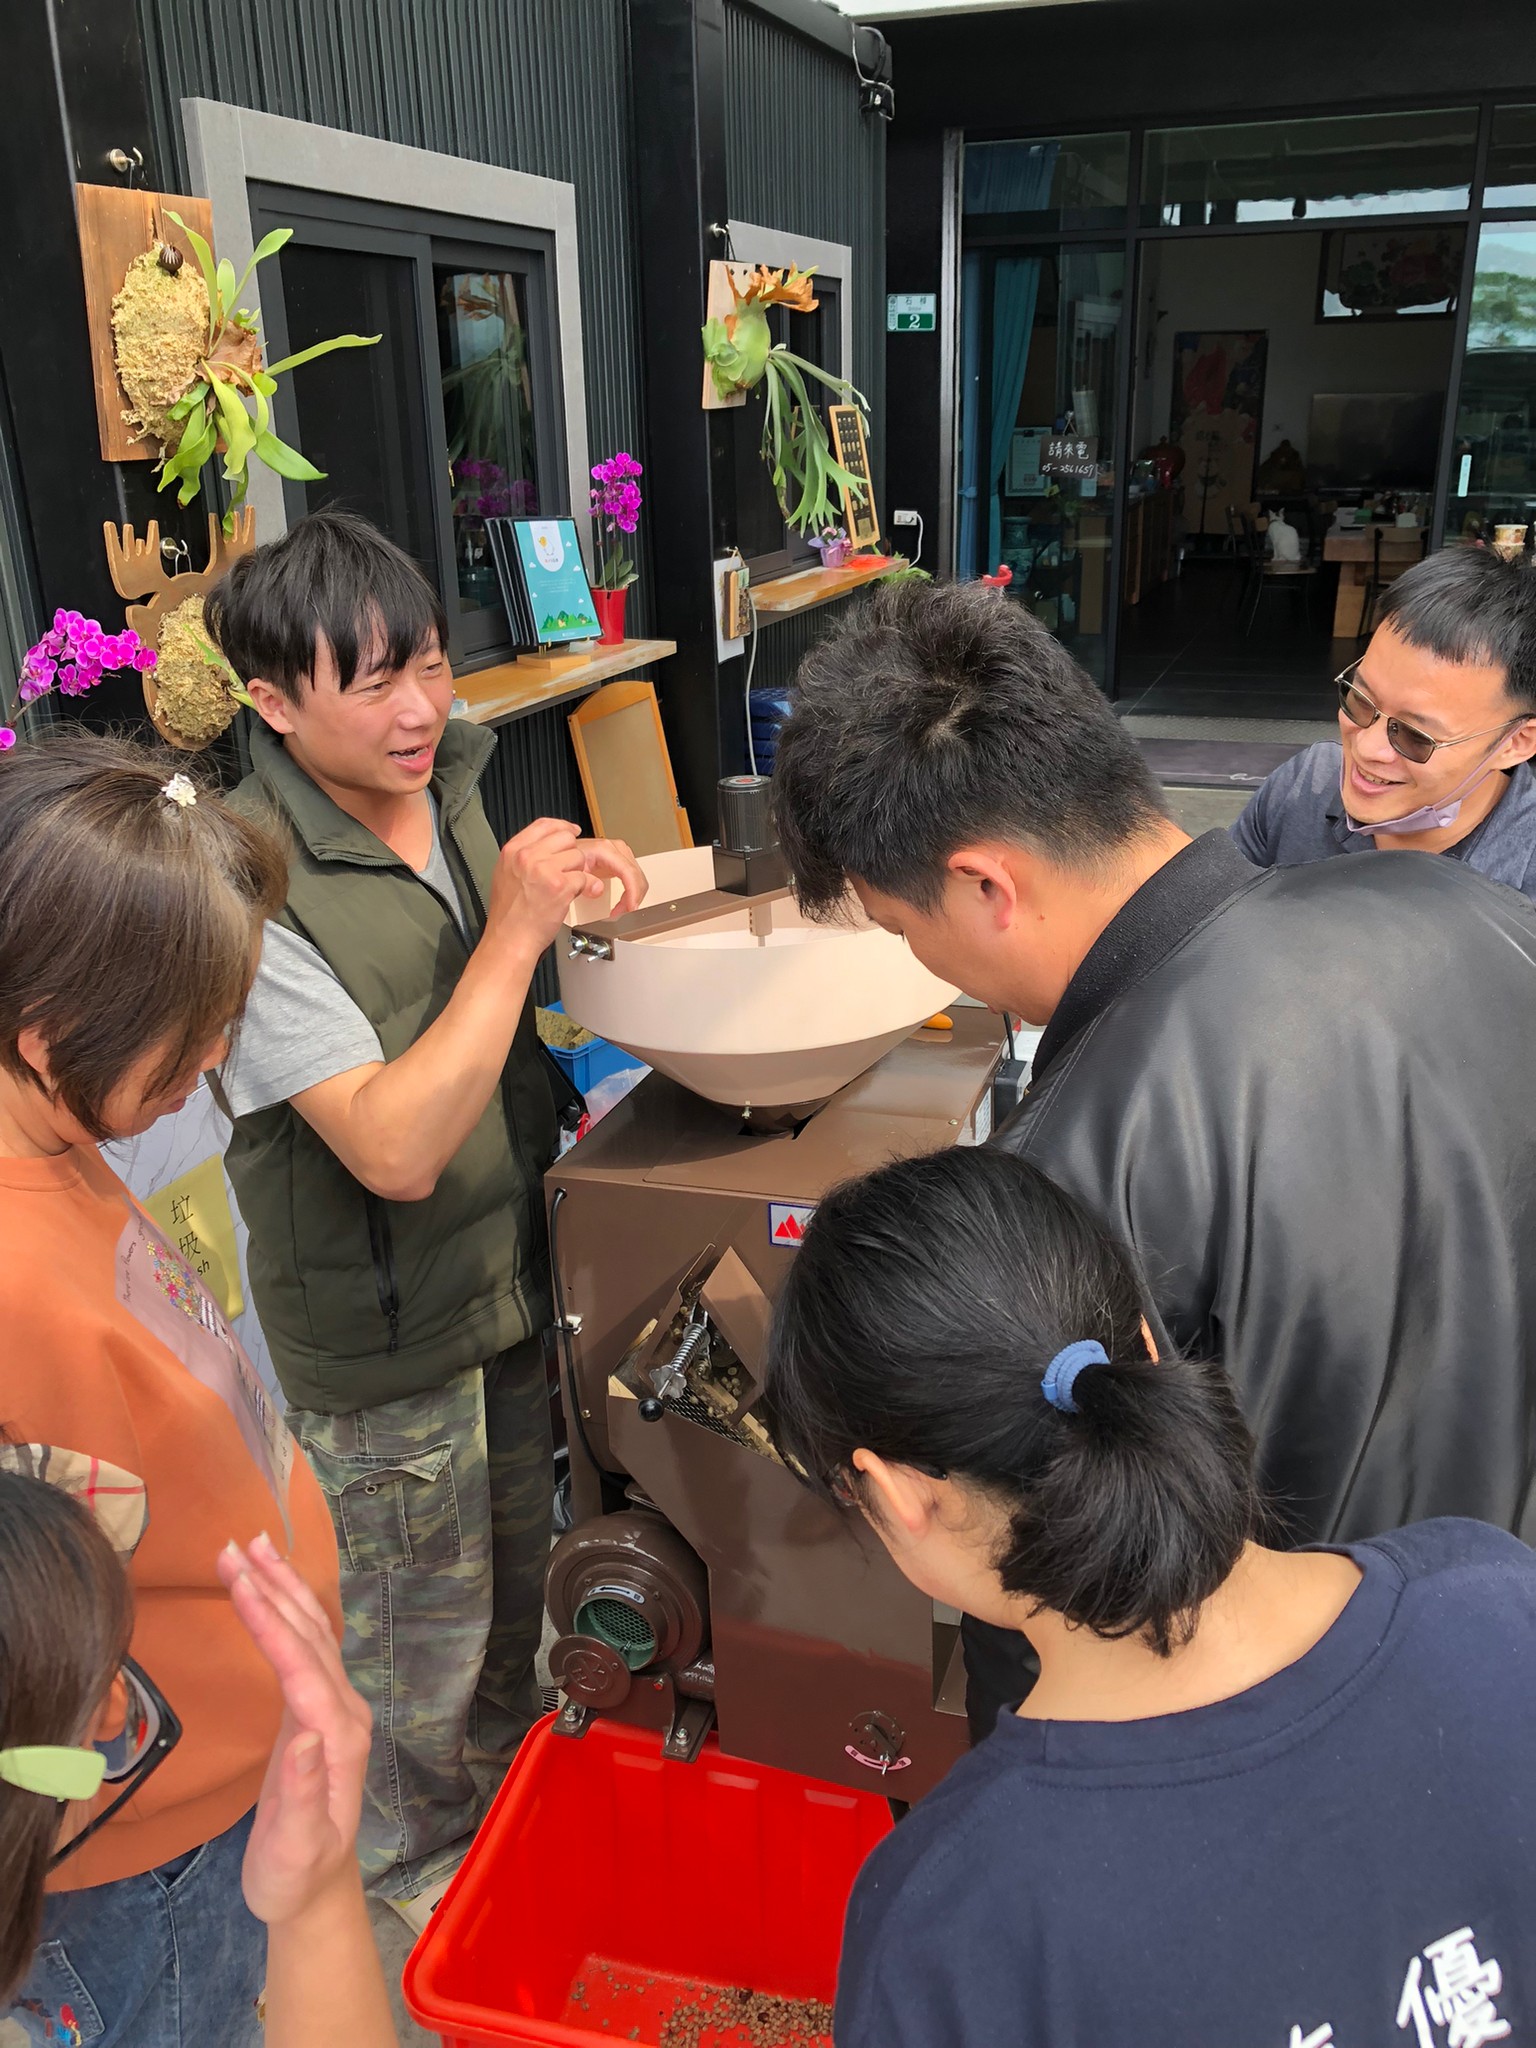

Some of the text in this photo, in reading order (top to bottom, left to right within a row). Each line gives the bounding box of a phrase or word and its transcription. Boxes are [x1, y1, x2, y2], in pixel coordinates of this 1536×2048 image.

[908, 314, 921, 329] 2
[1048, 441, 1089, 459] 請來電
[170, 1195, 201, 1262] 垃圾
[1396, 1926, 1512, 2048] 優
